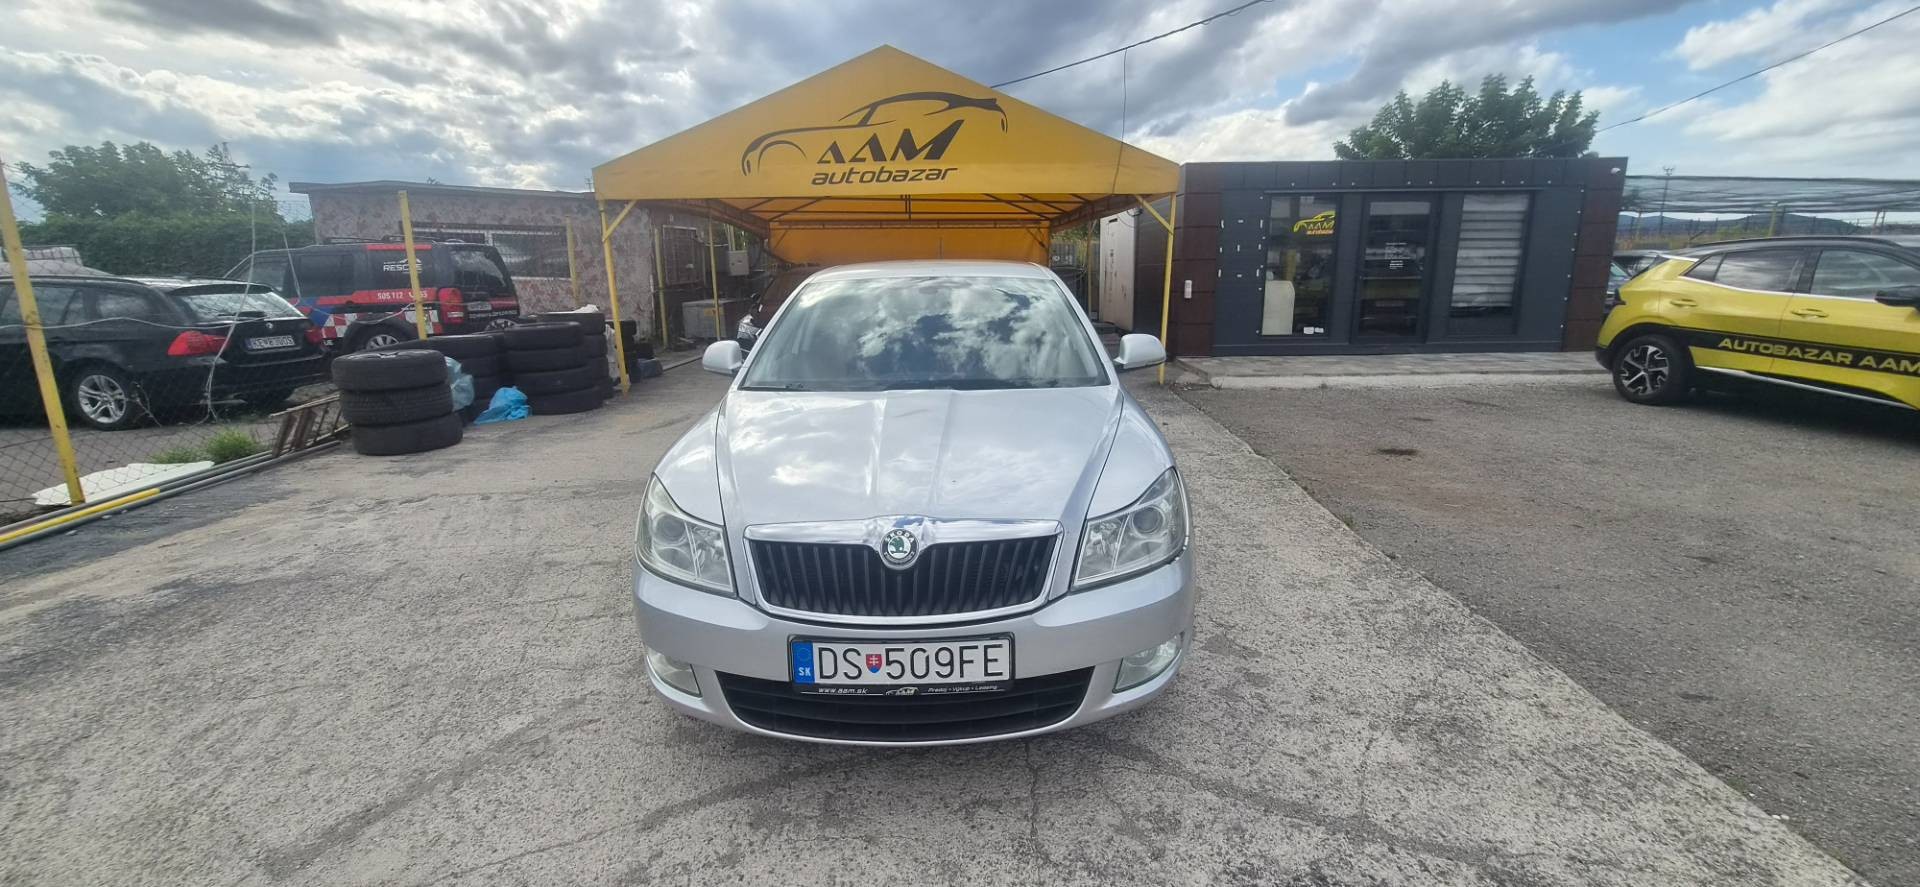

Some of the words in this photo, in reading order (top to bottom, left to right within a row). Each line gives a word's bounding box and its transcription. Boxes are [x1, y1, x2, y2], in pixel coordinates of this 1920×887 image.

[817, 119, 965, 164] AAM
[811, 165, 958, 185] autobazar
[1718, 338, 1853, 364] AUTOBAZAR
[1858, 355, 1920, 374] AAM
[798, 666, 811, 677] SK
[818, 646, 862, 680] DS
[885, 644, 1003, 680] 509FE
